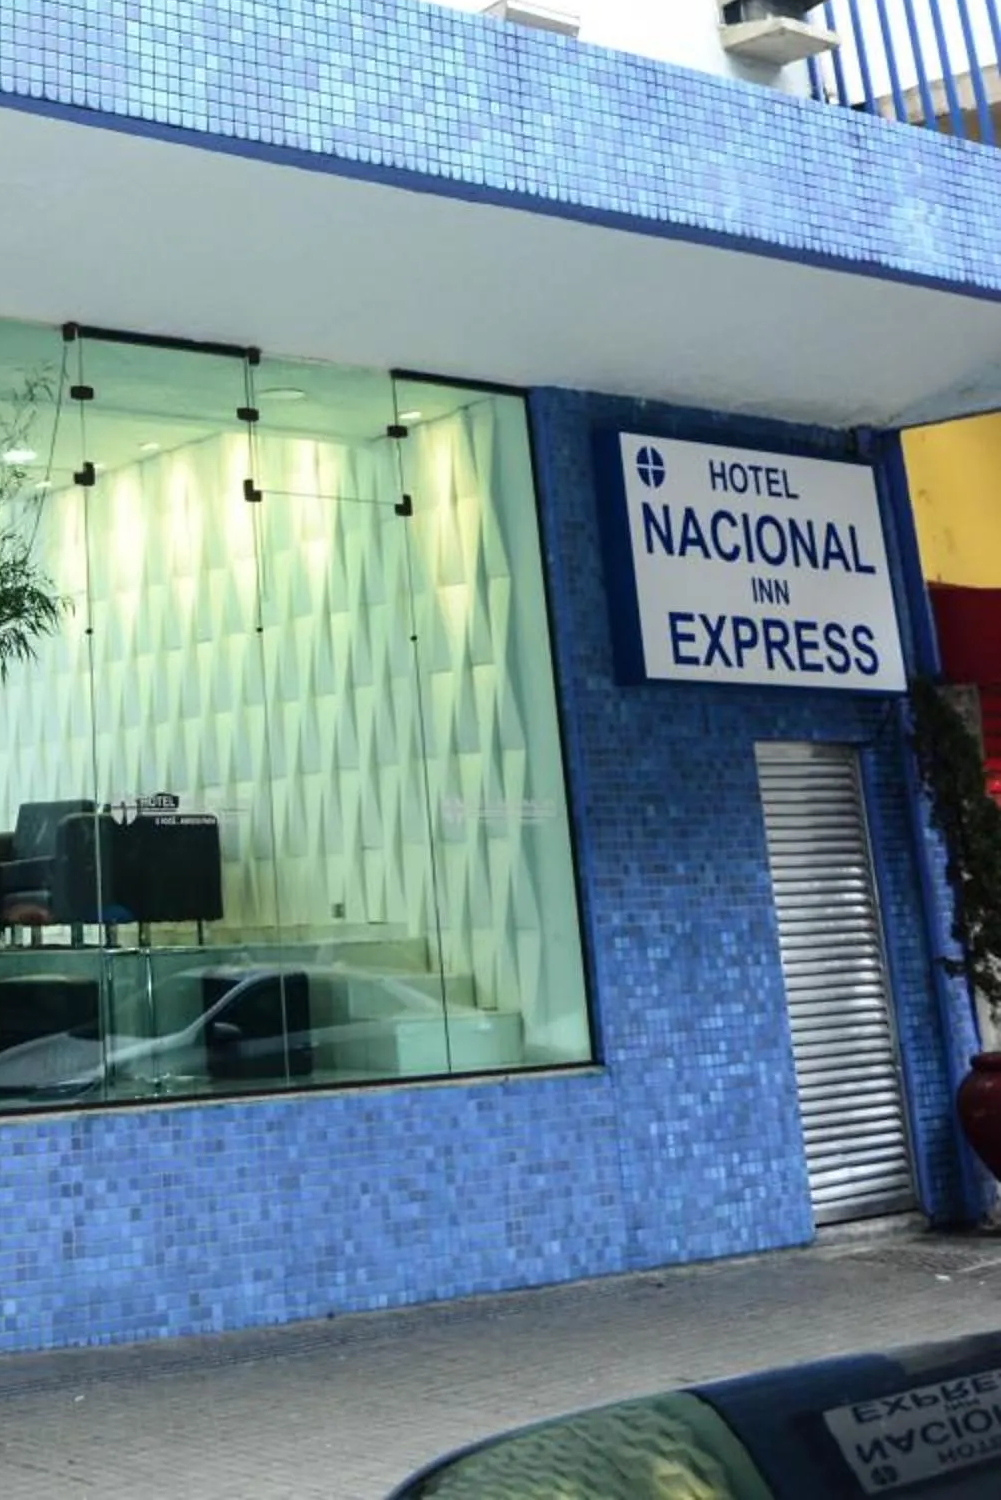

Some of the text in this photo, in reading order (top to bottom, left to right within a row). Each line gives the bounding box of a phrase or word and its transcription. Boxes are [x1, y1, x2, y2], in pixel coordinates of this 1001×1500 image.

[708, 460, 799, 499] HOTEL
[641, 502, 876, 574] NACIONAL
[752, 577, 790, 605] INN
[668, 611, 879, 676] EXPRESS
